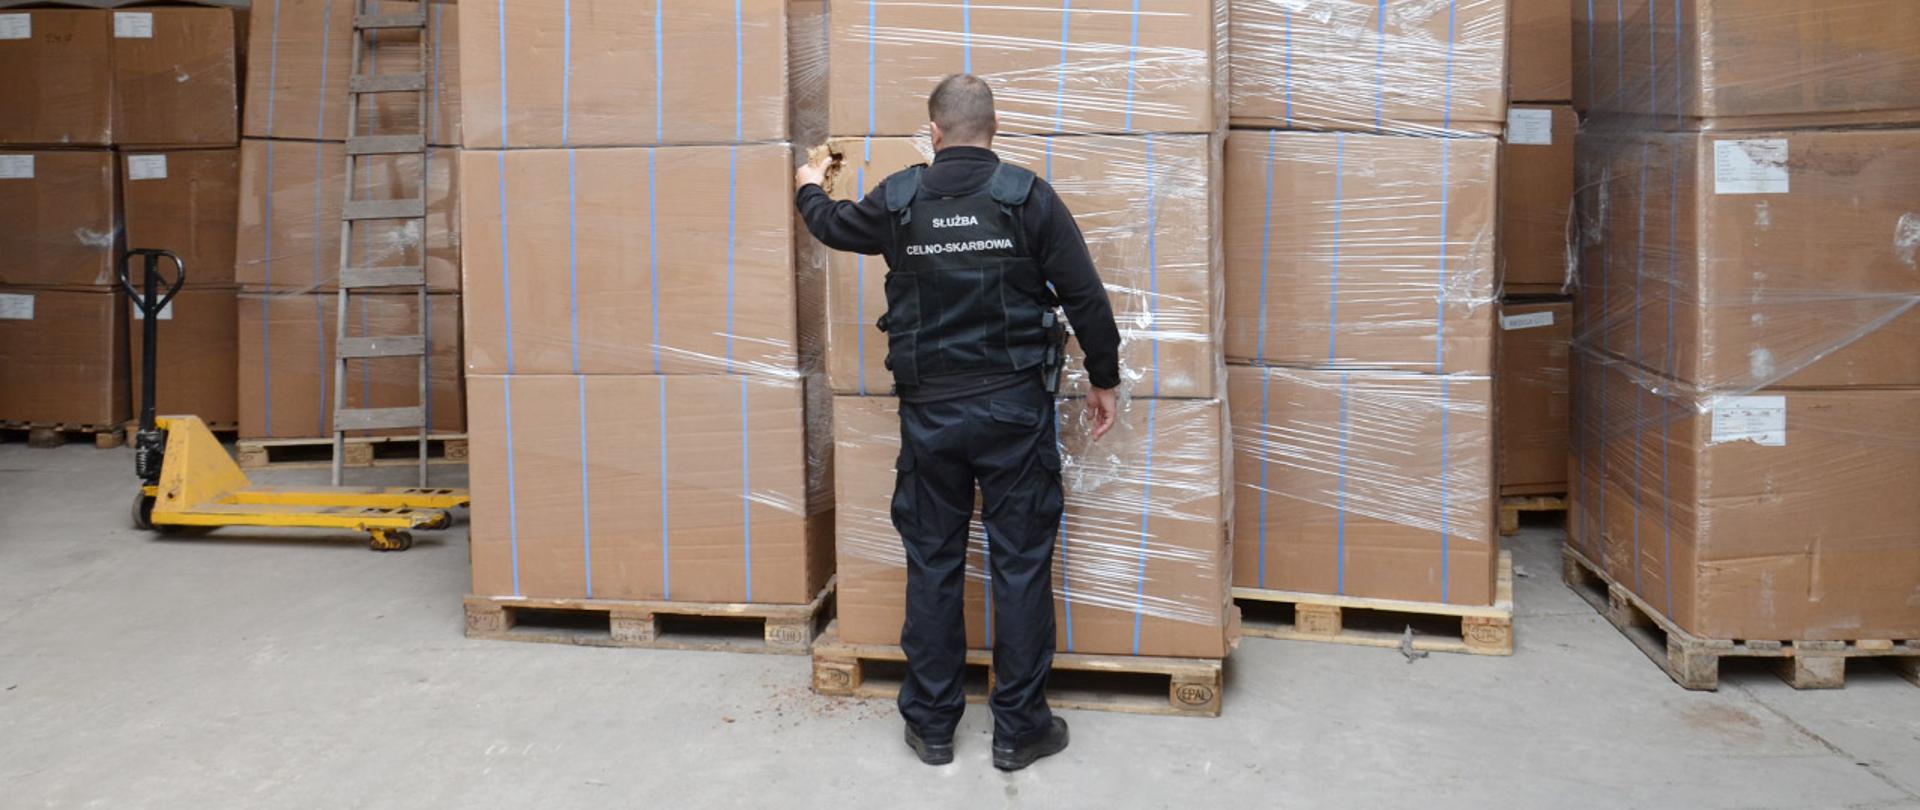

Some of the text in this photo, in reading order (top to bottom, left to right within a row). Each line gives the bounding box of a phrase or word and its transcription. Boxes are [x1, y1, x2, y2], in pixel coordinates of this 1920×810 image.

[932, 214, 978, 228] SŁUŻBA
[906, 239, 1013, 255] CELNO-SKARBOWA
[1182, 687, 1208, 701] EPAL
